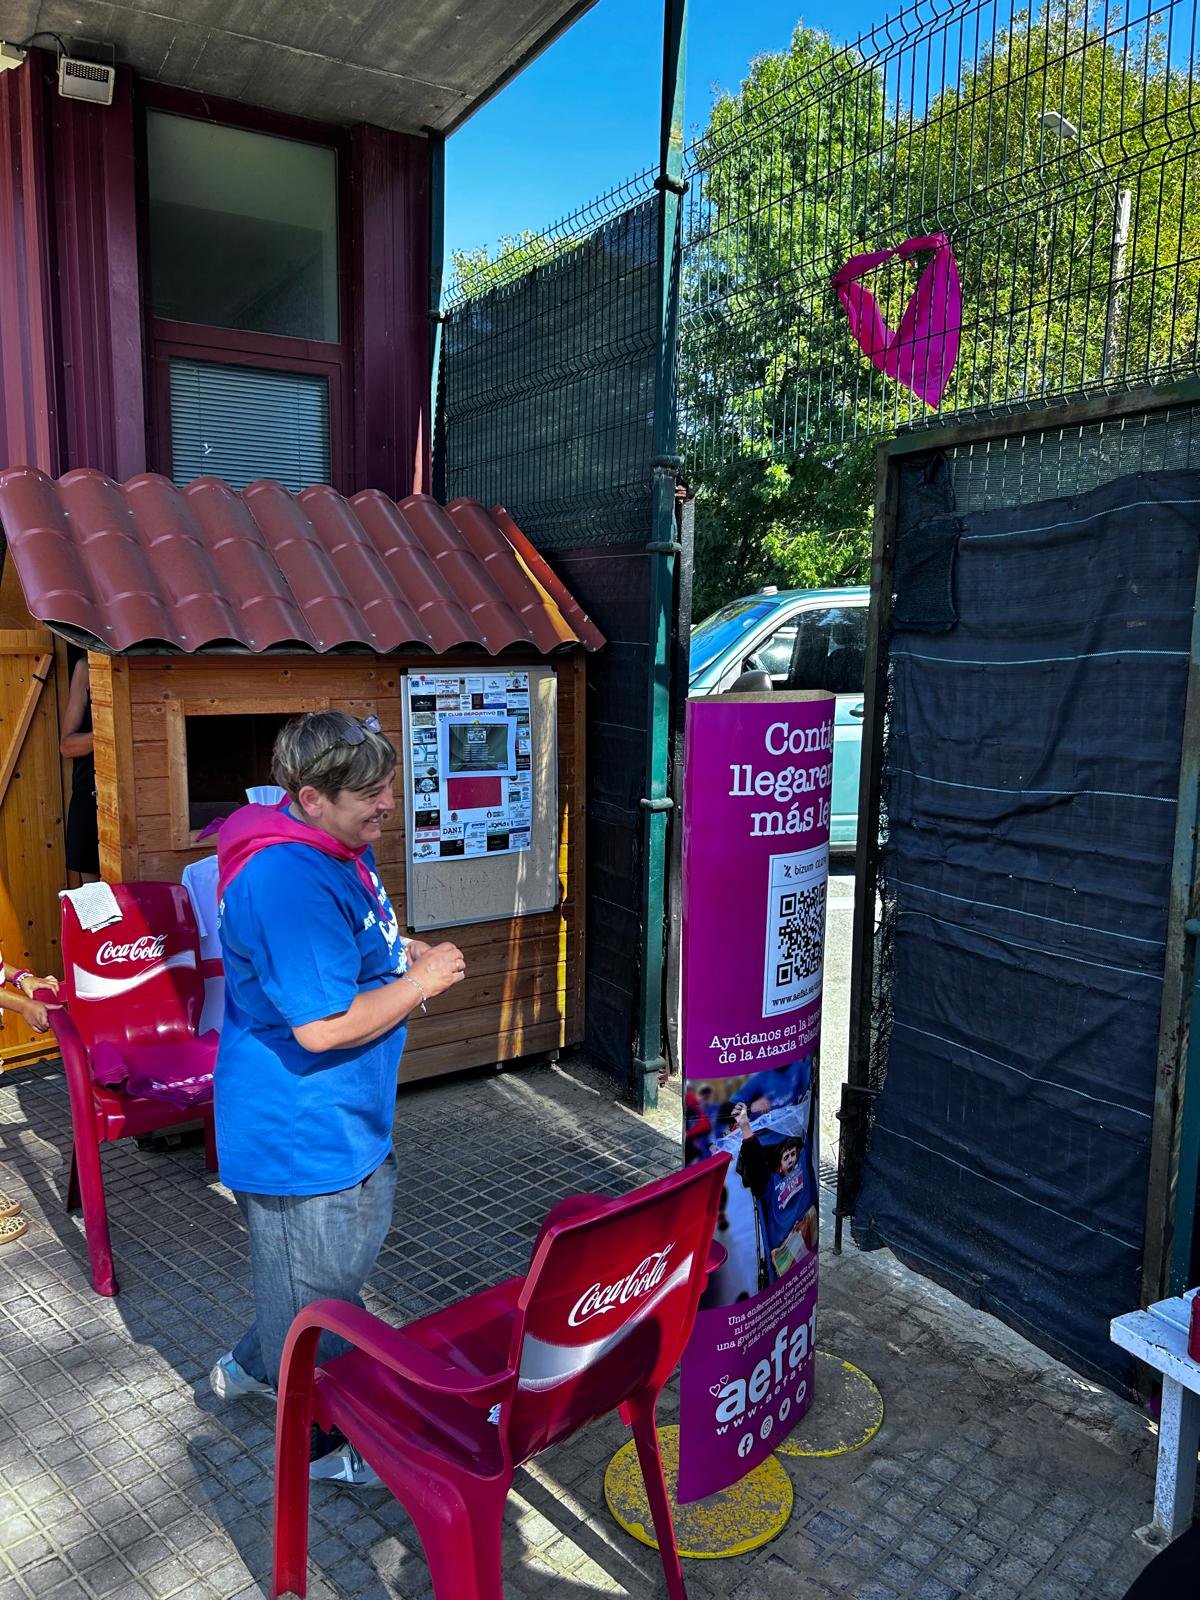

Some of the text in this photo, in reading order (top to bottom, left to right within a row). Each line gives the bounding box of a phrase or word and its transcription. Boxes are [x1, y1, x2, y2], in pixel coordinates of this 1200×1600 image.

[750, 802, 814, 836] más
[443, 827, 462, 836] DANI
[794, 863, 814, 876] bizum
[96, 934, 168, 966] Coca-Cola
[709, 1031, 781, 1051] Ayúdanos
[784, 1024, 797, 1037] en
[798, 1018, 807, 1032] la
[718, 1051, 737, 1065] de
[740, 1049, 754, 1062] la
[756, 1040, 797, 1059] Ataxia
[568, 1240, 676, 1327] Coca-Cola
[728, 1313, 746, 1326] Una
[734, 1325, 743, 1336] ni
[716, 1339, 736, 1352] una
